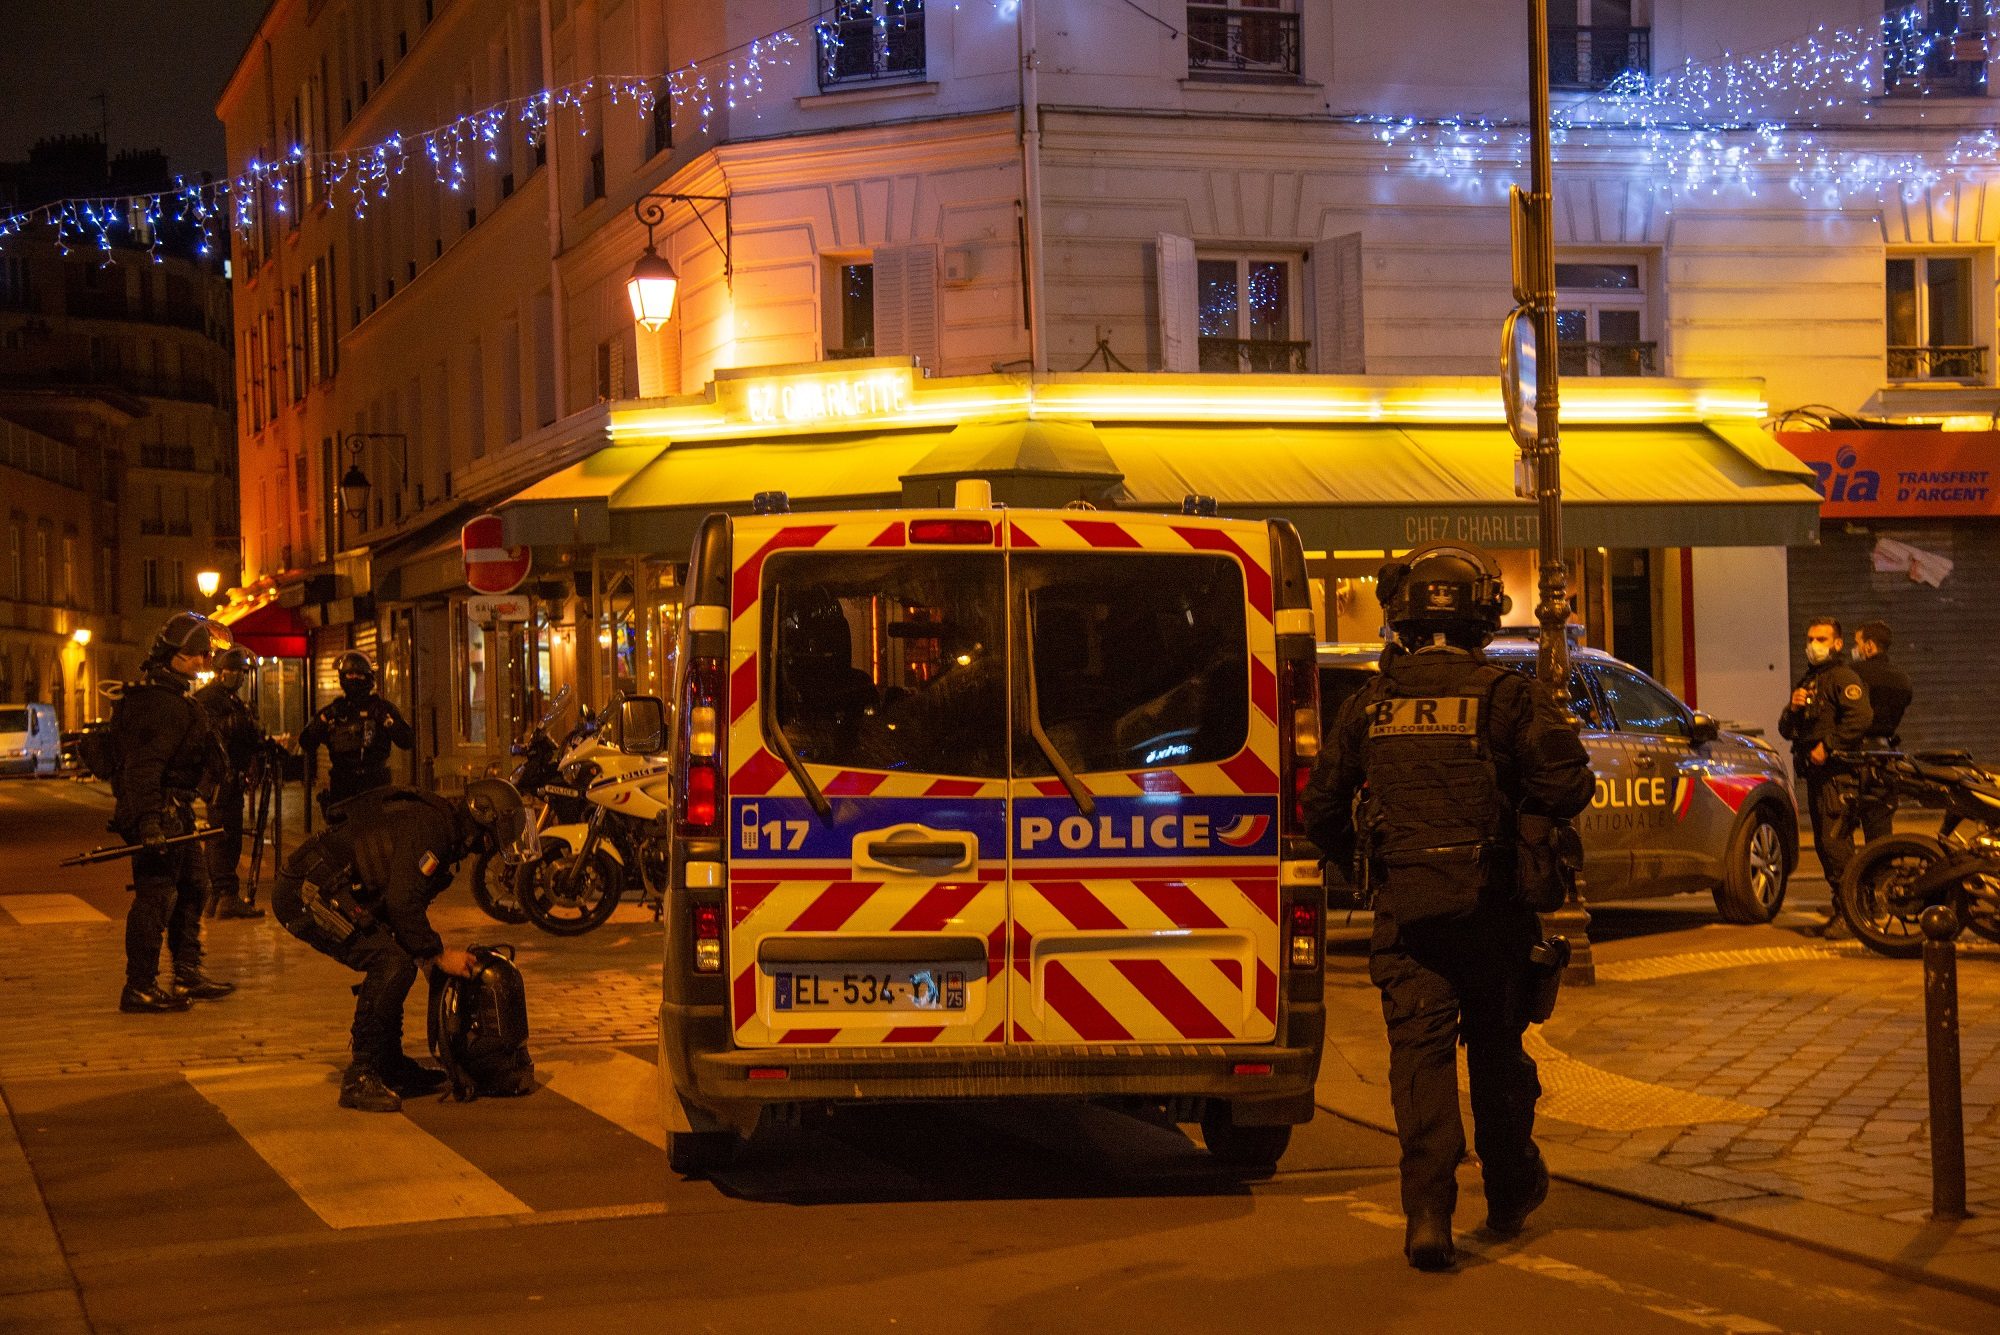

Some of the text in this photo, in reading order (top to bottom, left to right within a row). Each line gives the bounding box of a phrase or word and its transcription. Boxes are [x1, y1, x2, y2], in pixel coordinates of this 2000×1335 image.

[782, 376, 905, 419] CARLETTE
[1897, 471, 1989, 484] TRANSFERT
[1897, 488, 1989, 502] D'ARGENT
[1406, 515, 1540, 542] CHEZ CHARLETT
[1374, 725, 1466, 734] ANTI-COMMANDO
[1591, 777, 1666, 809] OLICE
[762, 820, 810, 850] 17
[1020, 815, 1210, 850] POLICE
[948, 990, 963, 1006] 75
